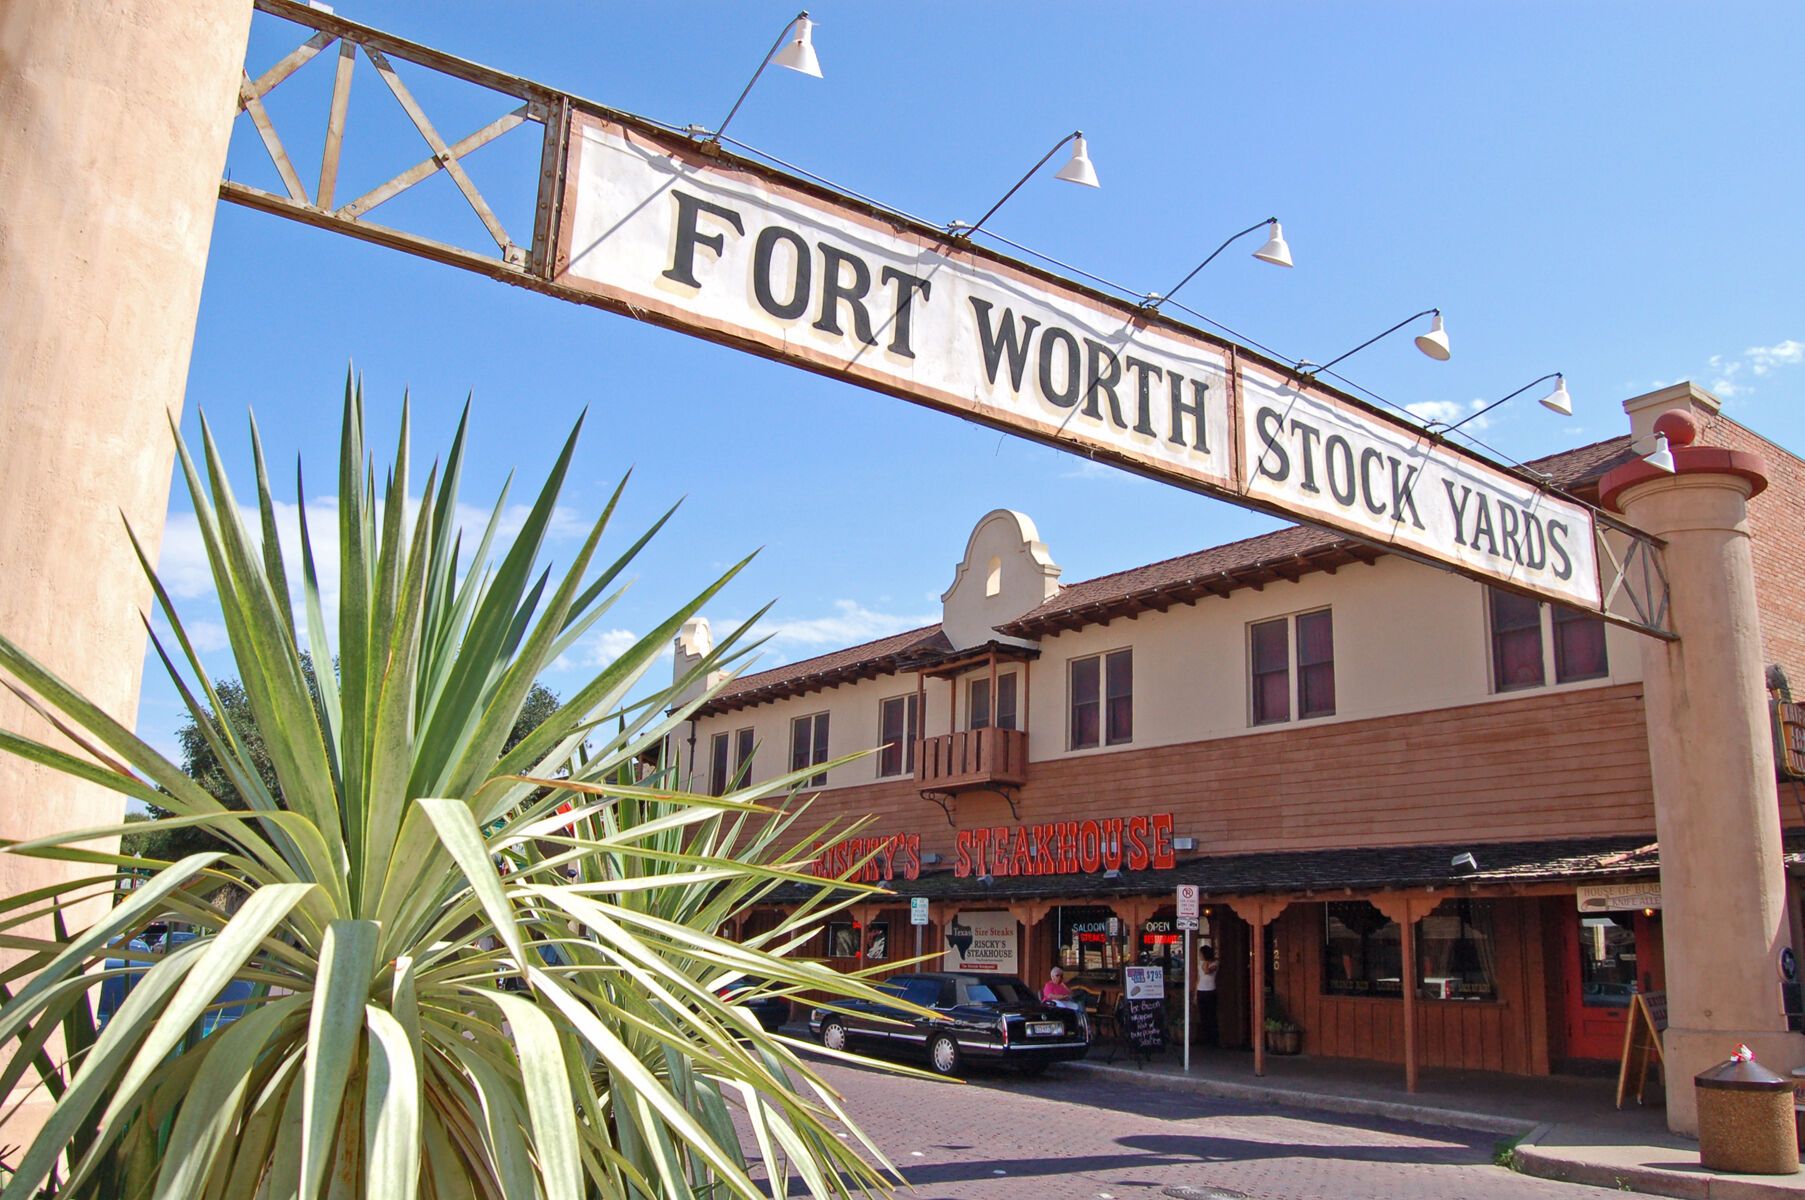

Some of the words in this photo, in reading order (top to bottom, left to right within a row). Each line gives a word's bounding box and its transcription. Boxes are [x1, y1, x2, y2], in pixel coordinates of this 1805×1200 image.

[660, 187, 932, 361] FORT
[967, 294, 1212, 456] WORTH
[1255, 406, 1427, 531] STOCK
[1441, 477, 1574, 582] YARDS
[812, 832, 920, 882] RISCKY'S
[955, 811, 1176, 877] STEAKHOUSE
[1584, 887, 1614, 897] HOUSE
[1619, 885, 1633, 895] OF
[1072, 922, 1106, 932] SALOON
[1146, 921, 1170, 932] OPEN
[953, 927, 971, 937] Texas
[989, 927, 1014, 937] Steaks
[974, 940, 1007, 949] RISCKY'S
[966, 949, 1013, 958] STEAKHOUSE
